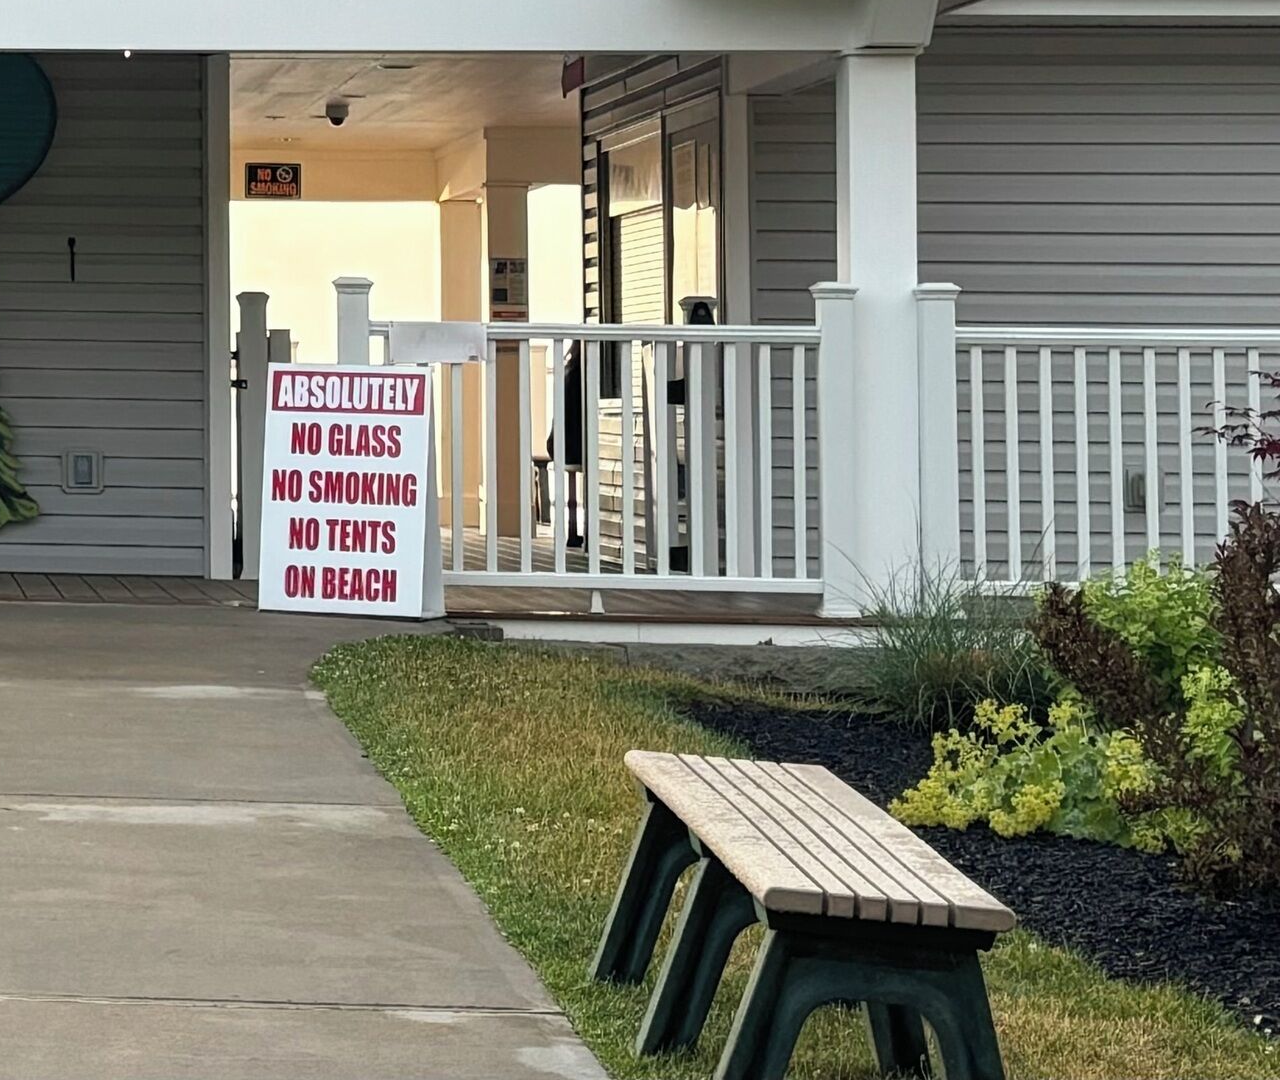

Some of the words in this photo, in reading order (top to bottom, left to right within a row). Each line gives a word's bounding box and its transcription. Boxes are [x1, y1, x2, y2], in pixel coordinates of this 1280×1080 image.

[250, 182, 297, 196] SMOKING
[257, 168, 271, 182] NO
[277, 374, 420, 411] ABSOLUTELY
[290, 422, 322, 456] NO
[328, 423, 401, 458] GLASS
[271, 469, 302, 502] NO
[308, 470, 417, 507] SMOKING
[288, 517, 320, 550] NO
[326, 519, 396, 554] TENTS
[284, 565, 315, 599] ON
[321, 567, 397, 602] BEACH
